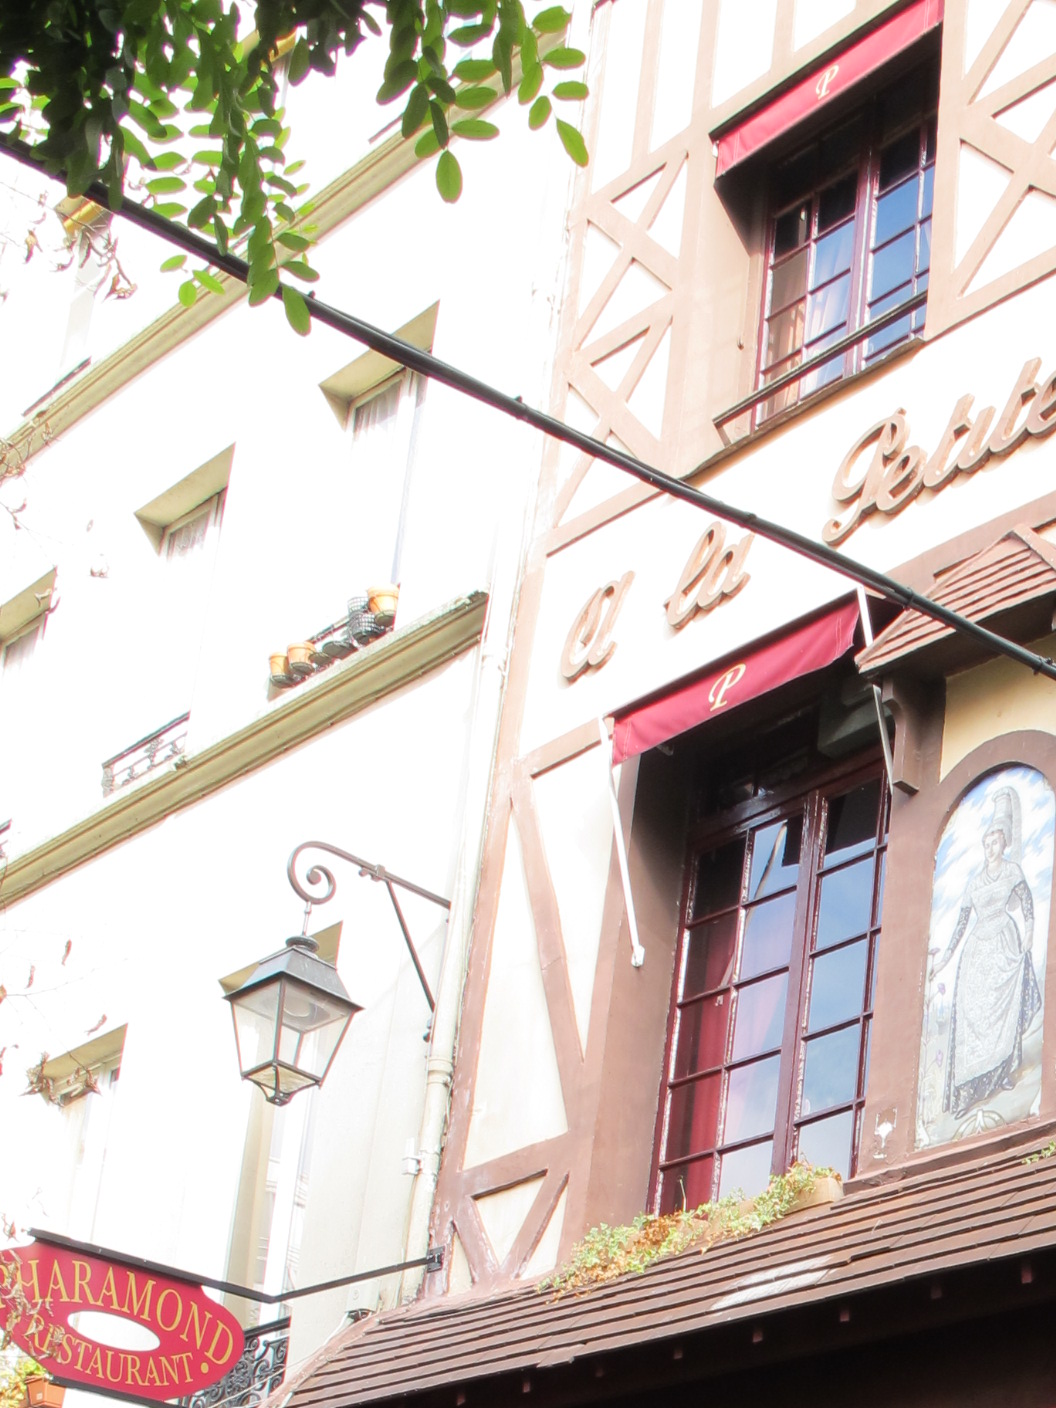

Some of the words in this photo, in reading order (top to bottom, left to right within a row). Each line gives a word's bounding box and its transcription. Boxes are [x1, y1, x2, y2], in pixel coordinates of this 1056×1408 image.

[815, 64, 839, 100] P
[662, 520, 757, 630] la
[708, 663, 747, 711] P
